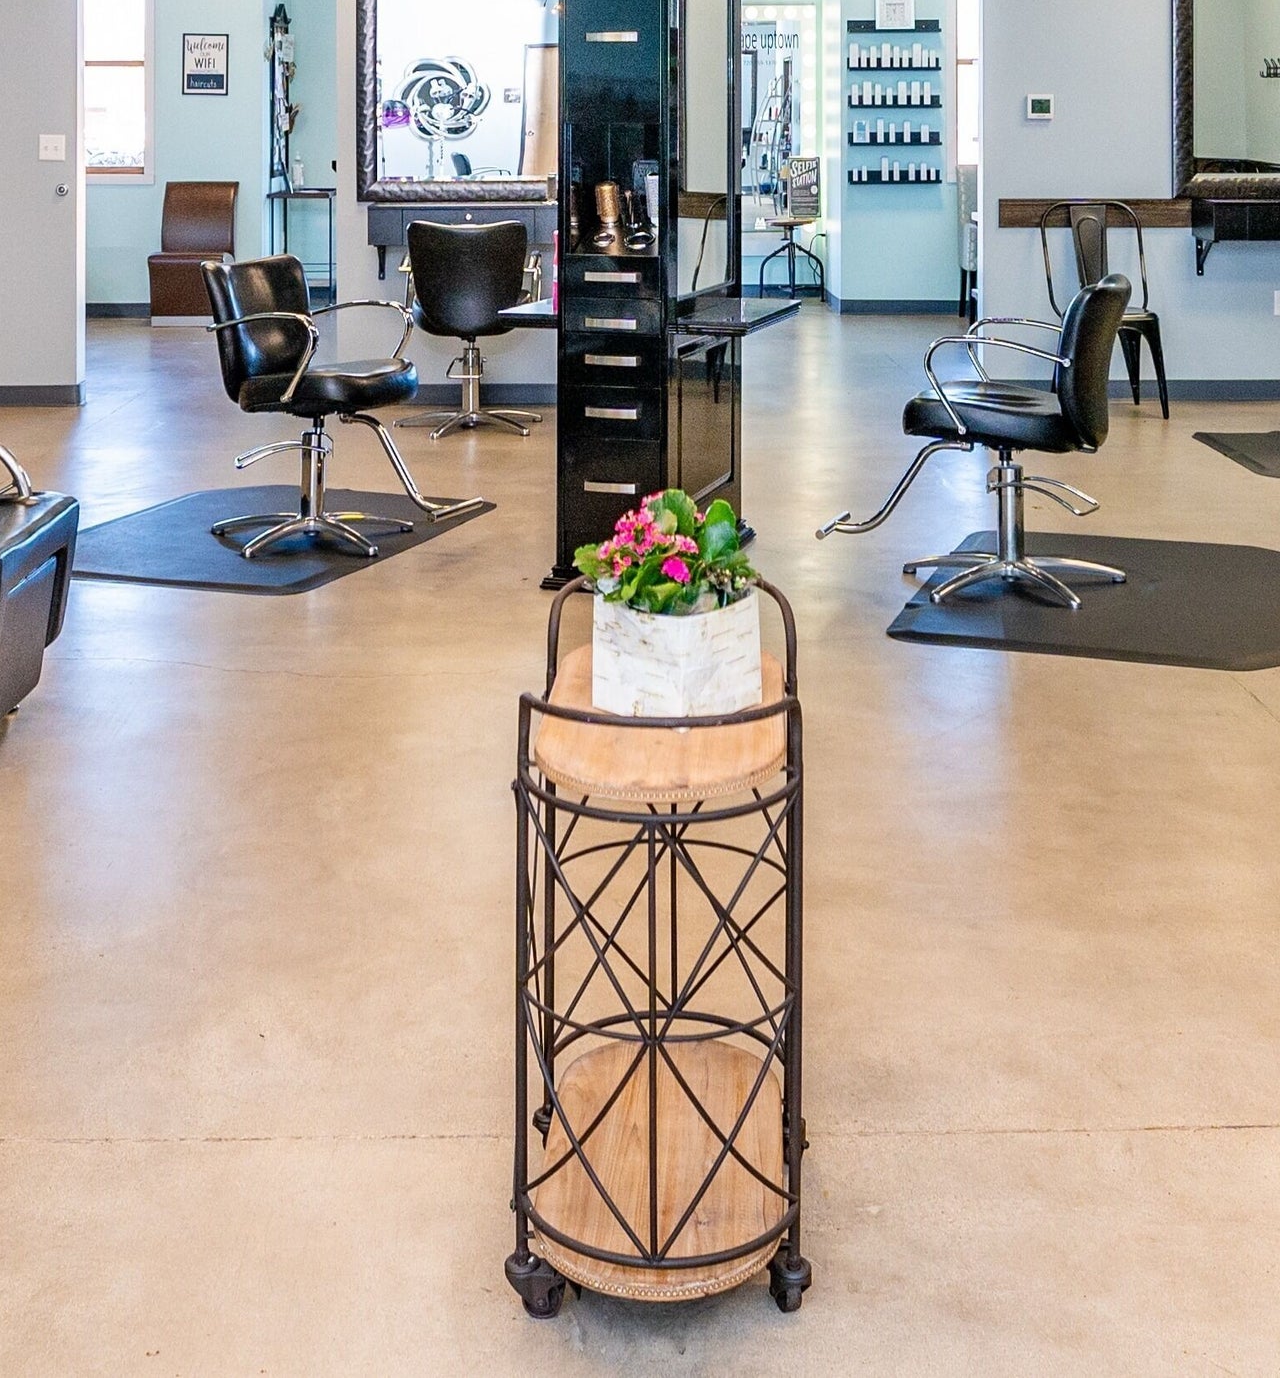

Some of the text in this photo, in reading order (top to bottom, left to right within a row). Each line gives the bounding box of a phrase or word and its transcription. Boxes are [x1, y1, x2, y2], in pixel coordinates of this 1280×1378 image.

[760, 30, 799, 55] uptown
[194, 57, 216, 69] WIFI
[790, 160, 818, 178] SELFIE
[792, 169, 818, 188] STATION
